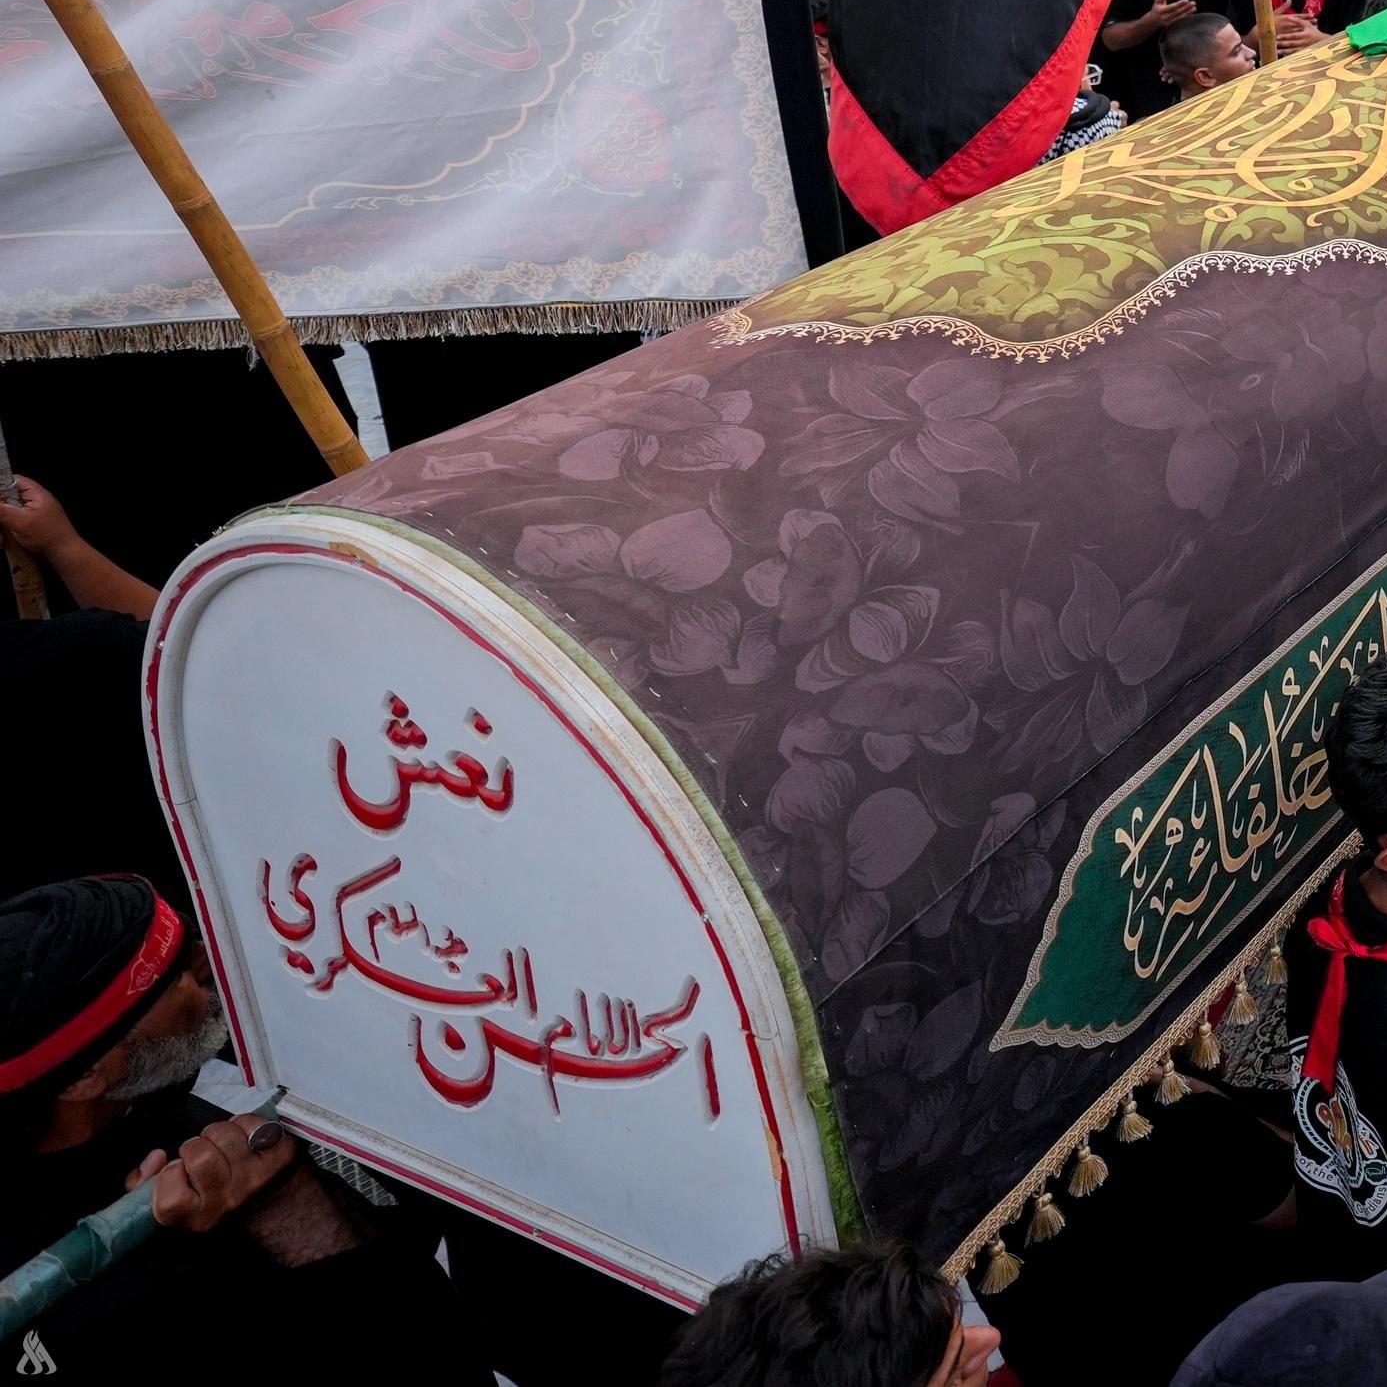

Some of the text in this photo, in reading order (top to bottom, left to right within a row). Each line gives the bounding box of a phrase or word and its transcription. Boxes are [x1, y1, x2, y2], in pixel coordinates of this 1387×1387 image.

[330, 690, 514, 838] نعش
[1299, 1158, 1312, 1170] of
[1313, 1166, 1334, 1182] the
